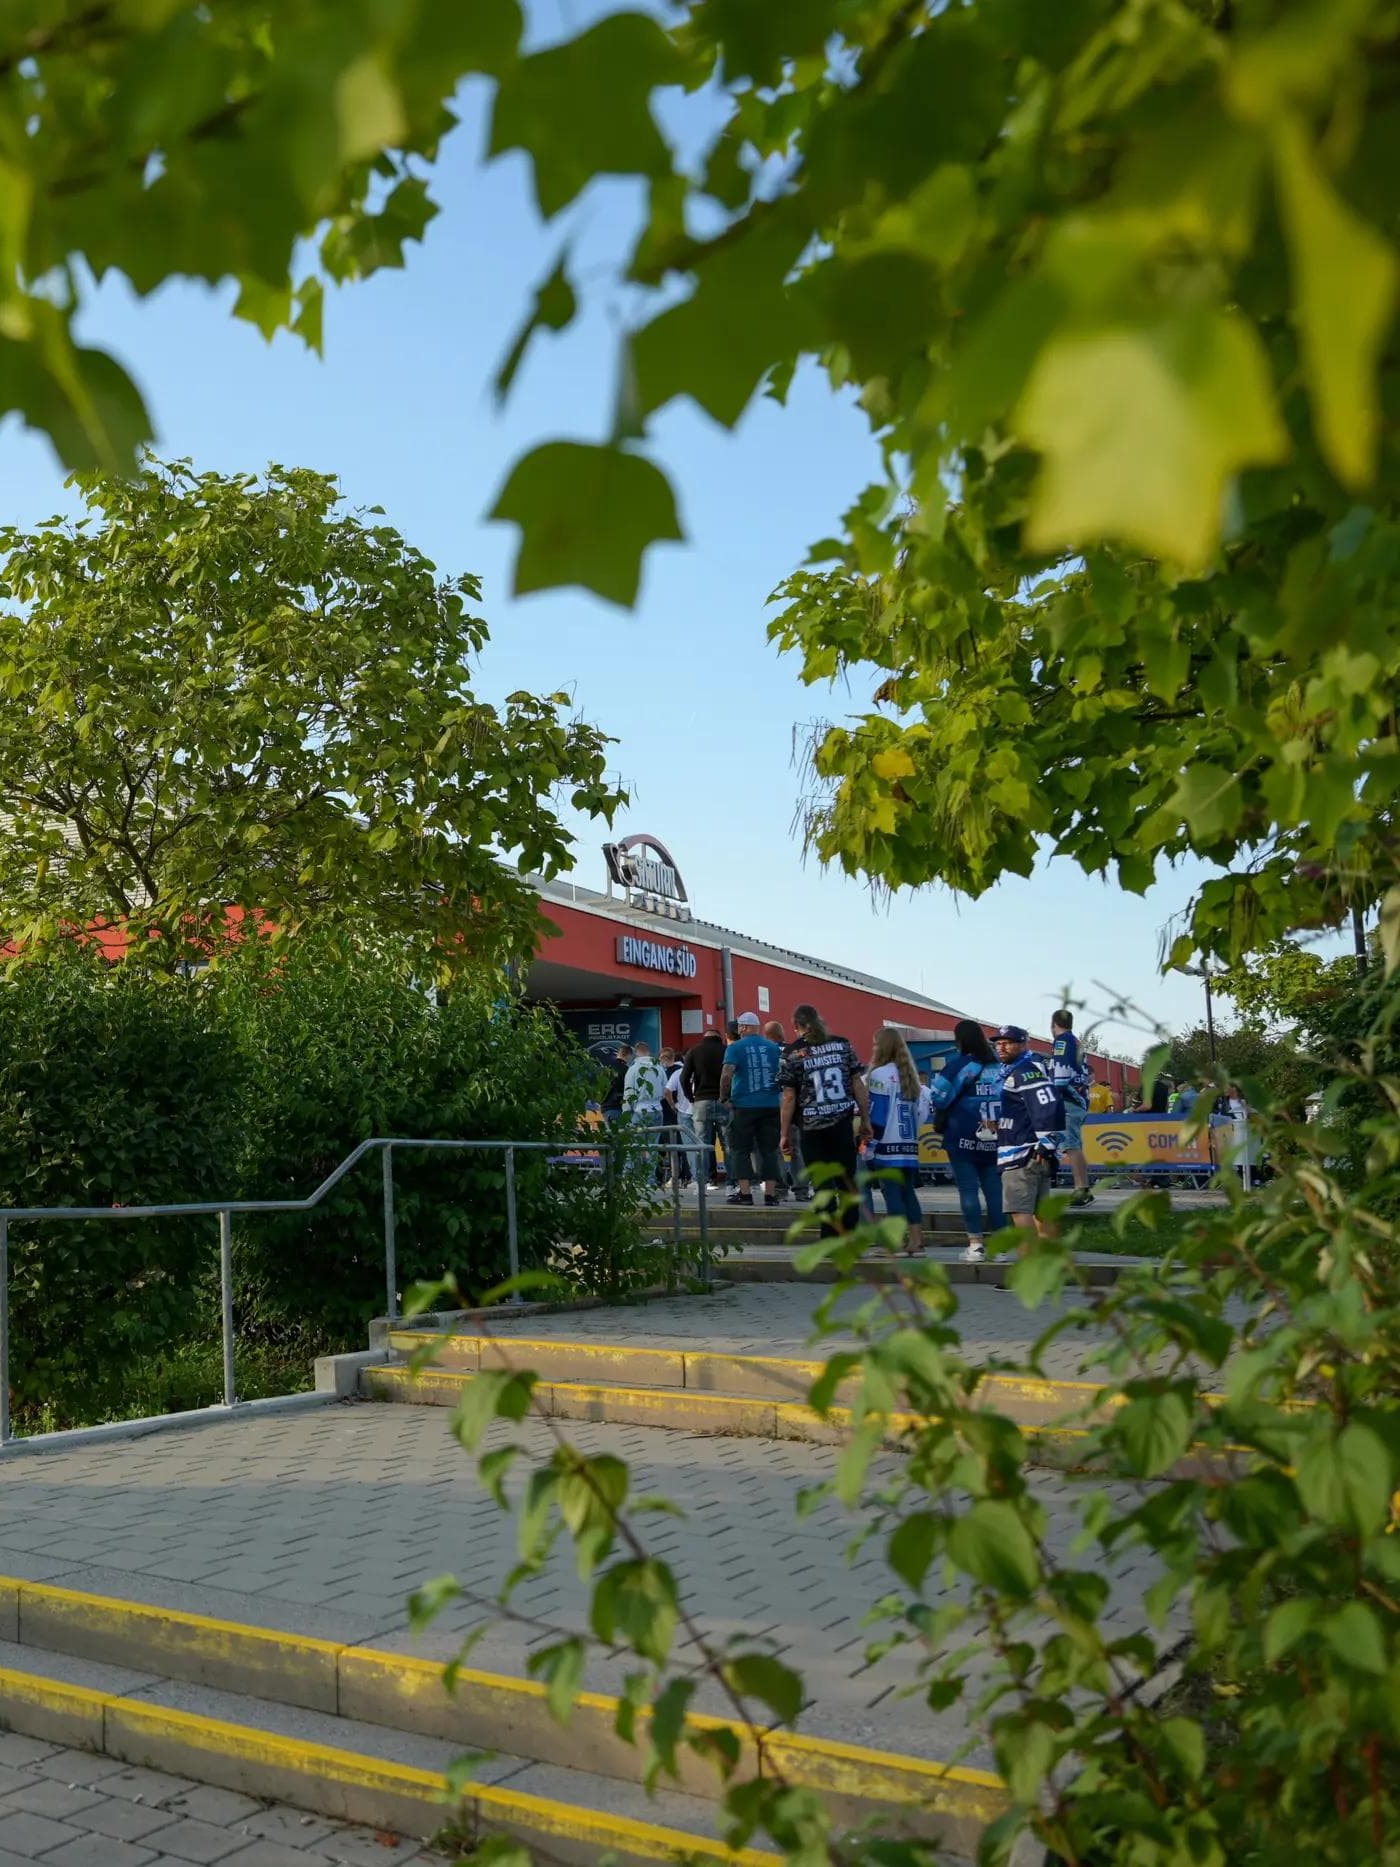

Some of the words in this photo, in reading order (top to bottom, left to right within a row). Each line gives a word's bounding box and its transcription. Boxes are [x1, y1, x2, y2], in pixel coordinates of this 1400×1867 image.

[623, 936, 674, 973] EINGANG
[676, 944, 697, 977] SÜD
[588, 1023, 631, 1035] ERC
[811, 1043, 843, 1055] SATURN
[808, 1067, 846, 1104] 13
[1036, 1086, 1056, 1105] 61
[959, 1138, 975, 1150] ERC
